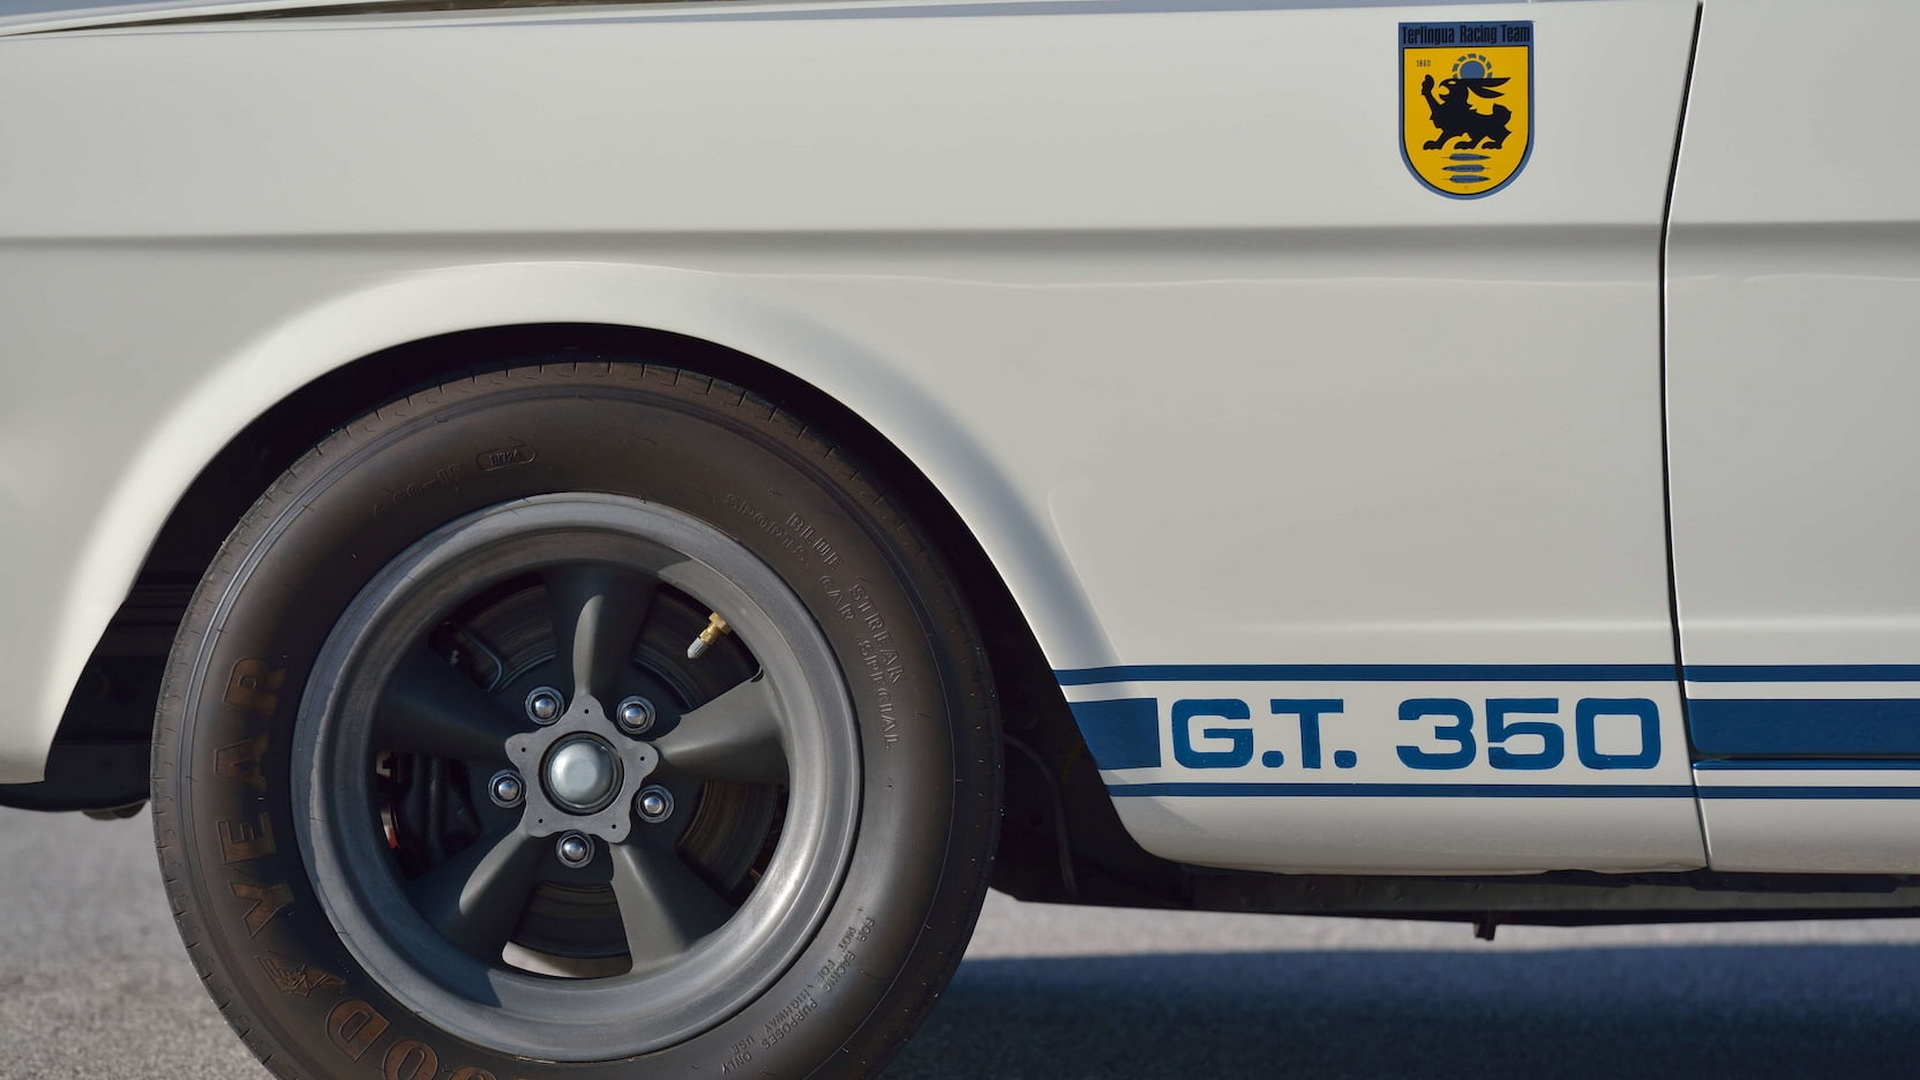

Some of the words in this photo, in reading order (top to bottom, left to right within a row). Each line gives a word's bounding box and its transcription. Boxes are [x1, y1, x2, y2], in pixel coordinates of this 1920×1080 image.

[1402, 26, 1455, 45] Terlingua
[1460, 25, 1497, 44] Racing
[1502, 24, 1530, 43] Team
[785, 511, 844, 571] BLUE
[849, 582, 906, 685] STREAK
[819, 574, 856, 624] CAR
[858, 639, 899, 749] SPECIAL
[1171, 698, 1357, 769] G.T.
[1396, 698, 1661, 770] 350
[838, 926, 857, 950] NOT
[858, 917, 875, 942] FOR
[823, 951, 856, 992] RACING
[761, 998, 818, 1050] PURPOSES
[764, 988, 811, 1033] HIGHWAY
[720, 1050, 752, 1076] ONLY
[731, 1034, 755, 1055] USE
